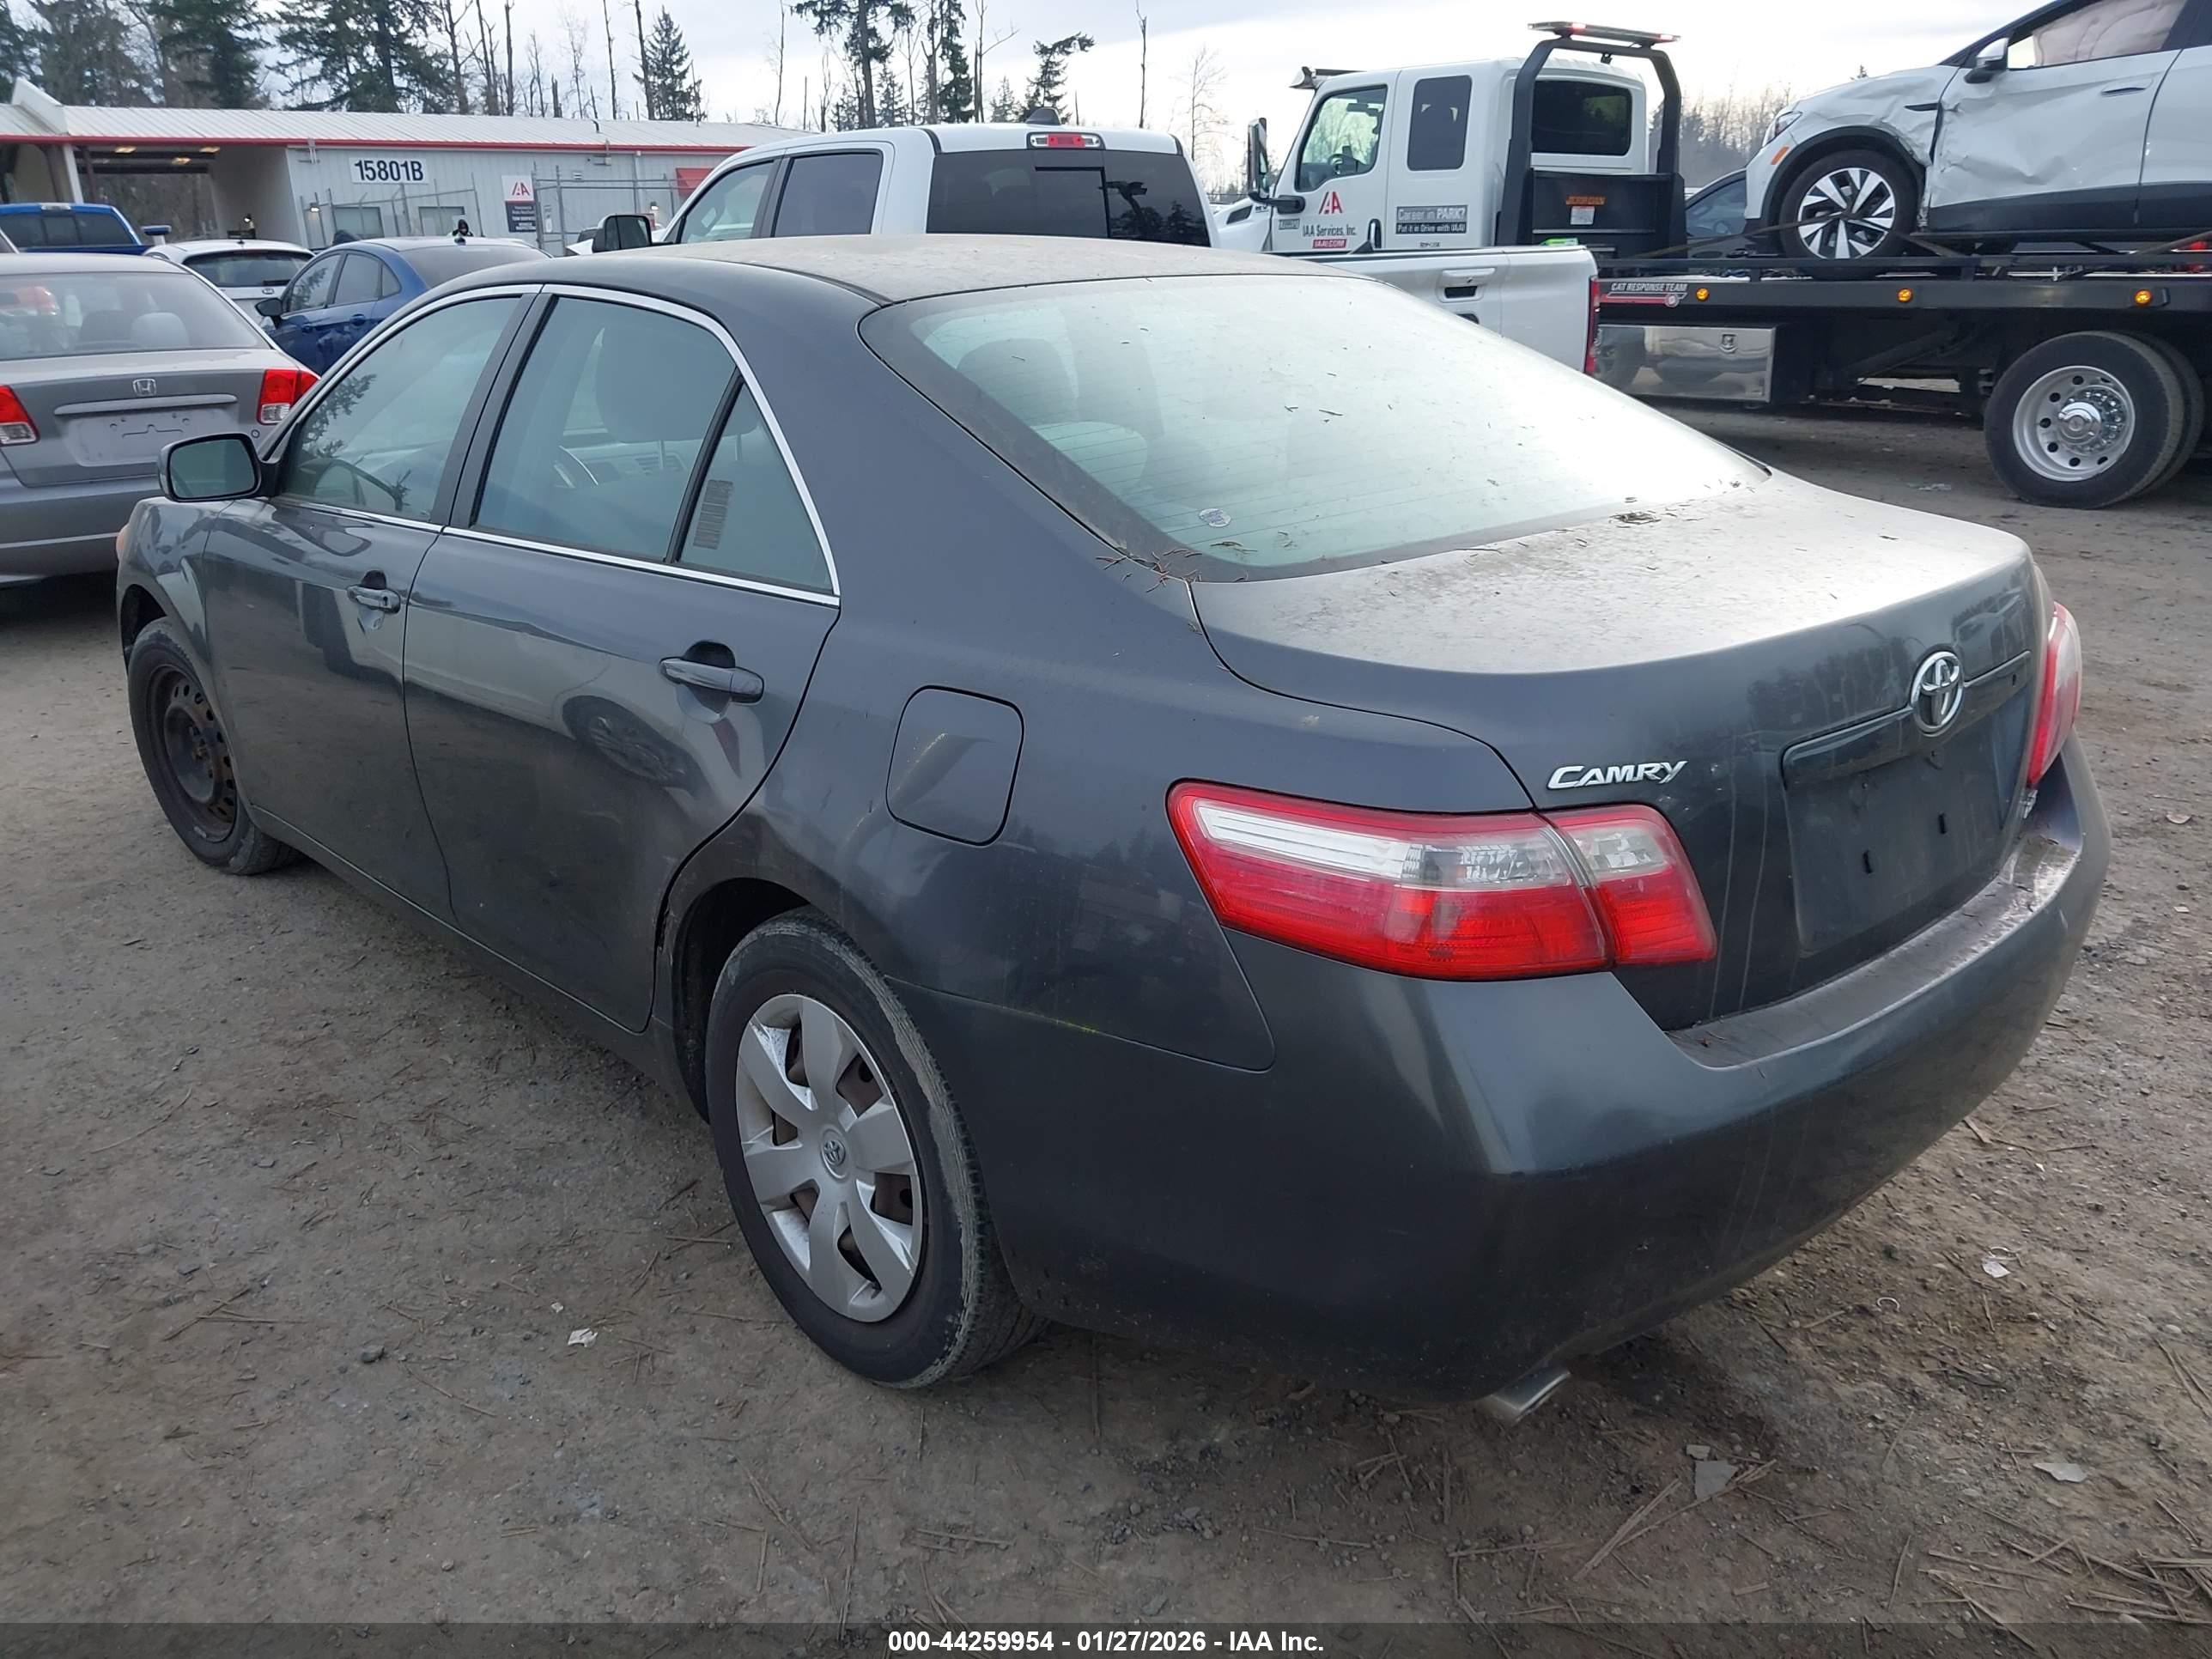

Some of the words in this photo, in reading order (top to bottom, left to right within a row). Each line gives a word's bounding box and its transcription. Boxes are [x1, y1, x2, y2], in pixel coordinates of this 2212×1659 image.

[354, 160, 424, 182] 15801B
[1611, 283, 1626, 291] CAT
[1626, 283, 1664, 291] RESPONSE
[1665, 283, 1688, 292] TEAM
[1547, 761, 1688, 790] CAMRY
